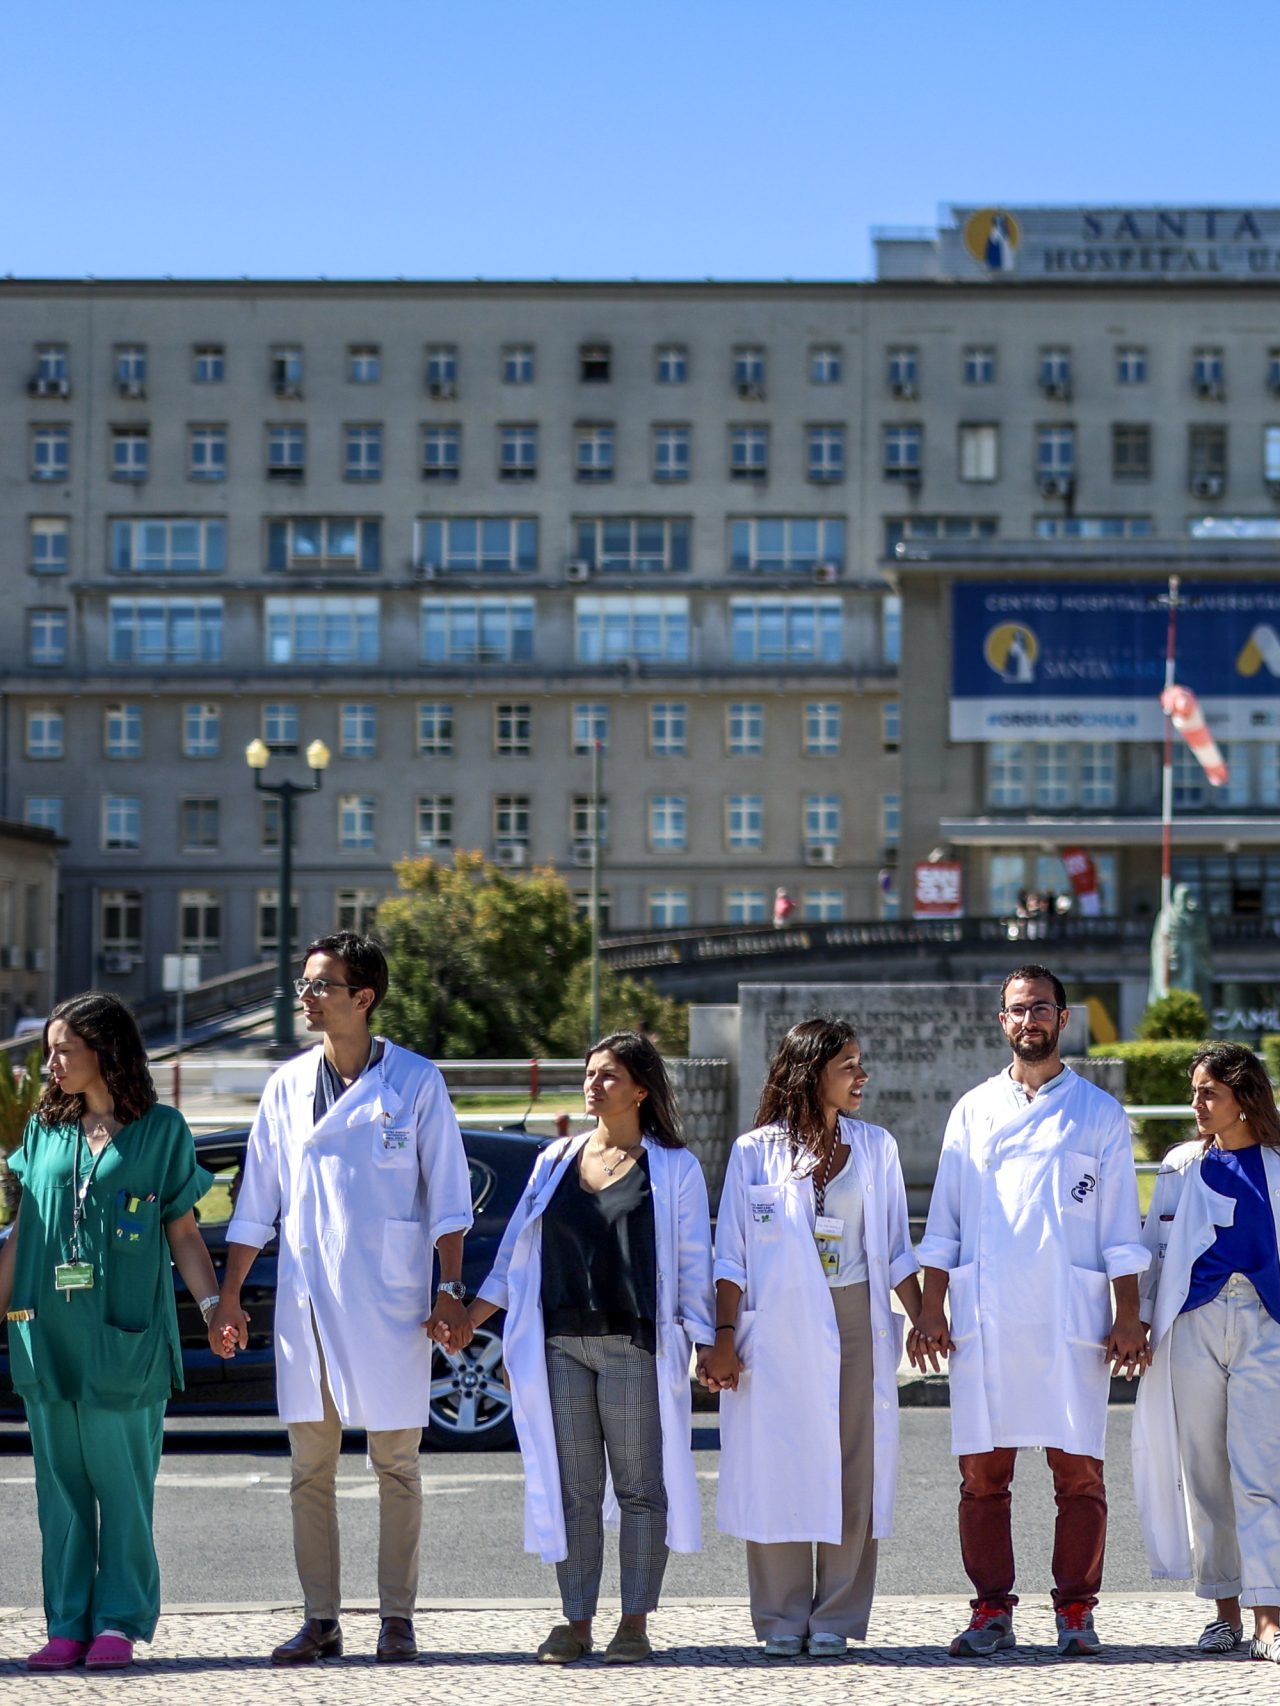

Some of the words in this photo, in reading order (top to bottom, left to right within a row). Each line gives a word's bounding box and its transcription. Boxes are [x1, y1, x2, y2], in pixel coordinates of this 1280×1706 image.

[1083, 212, 1262, 242] SANTA
[1044, 248, 1221, 273] HOSPITAL
[985, 594, 1058, 612] CENTRO
[1042, 658, 1114, 681] SANTA
